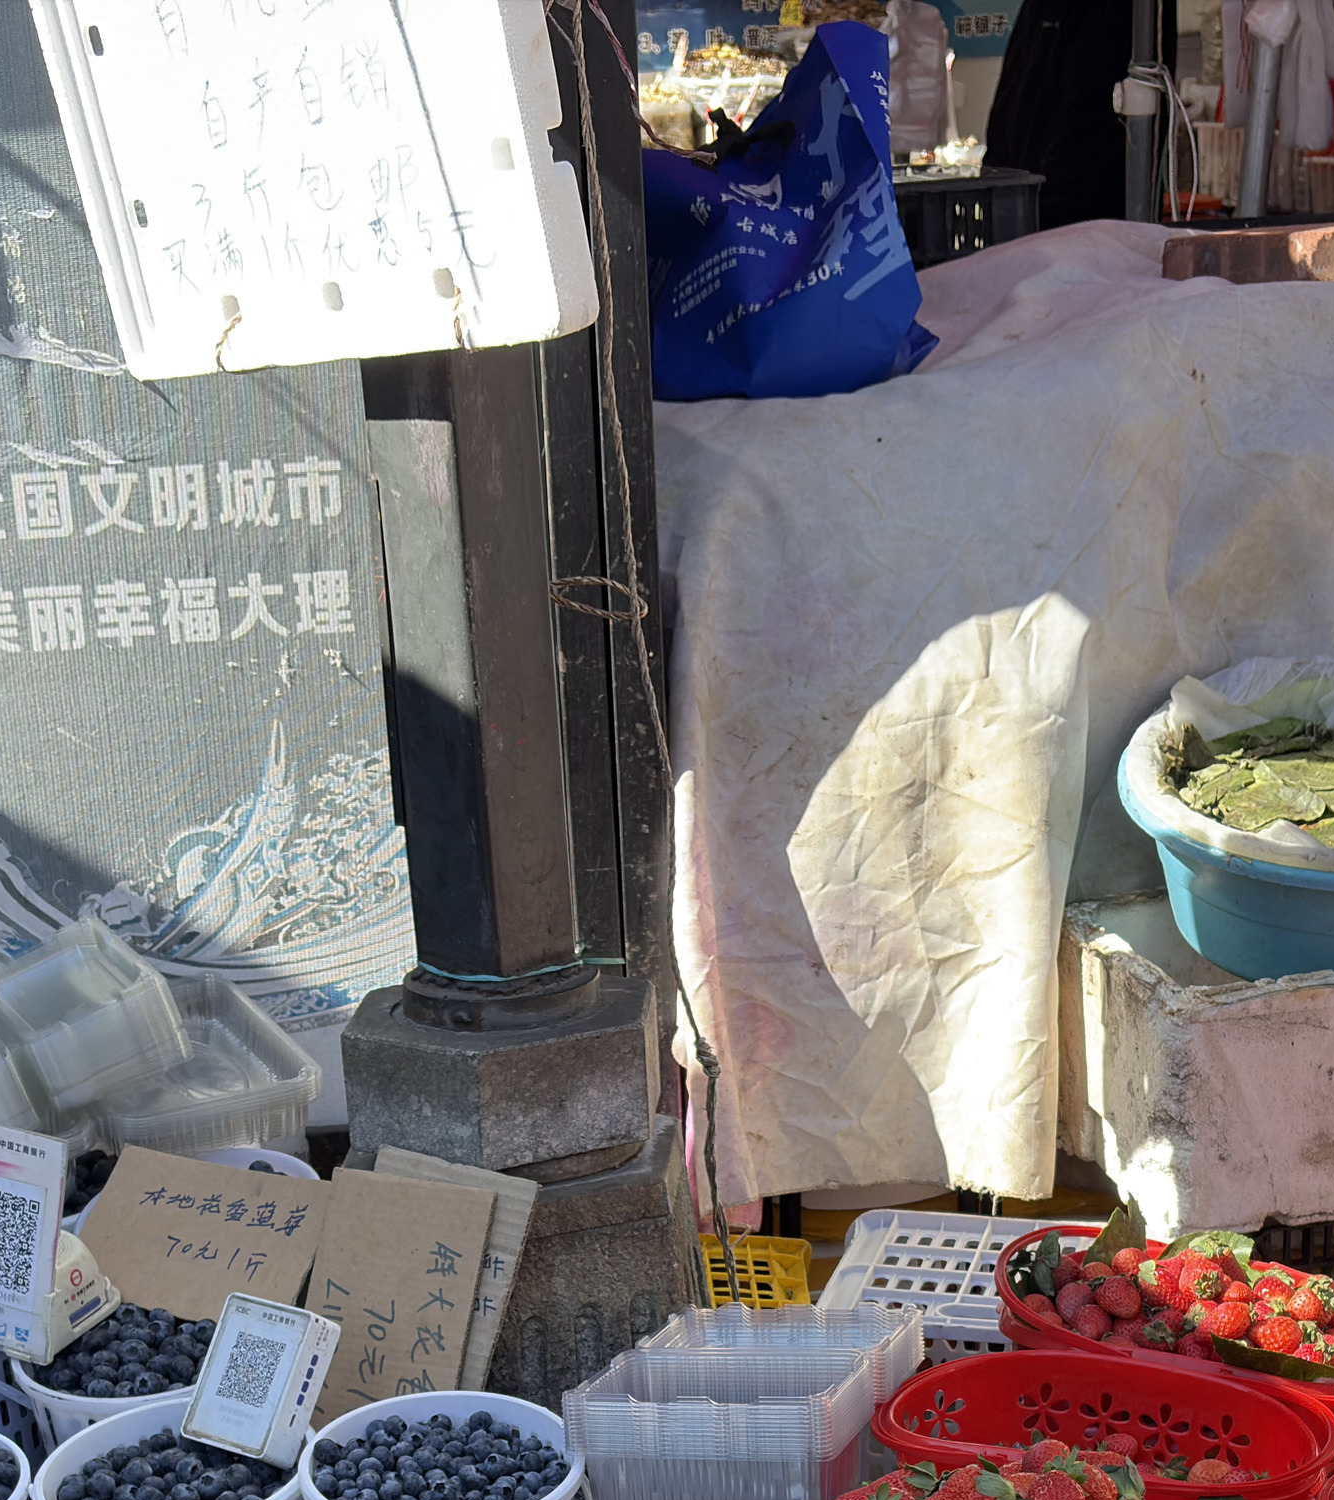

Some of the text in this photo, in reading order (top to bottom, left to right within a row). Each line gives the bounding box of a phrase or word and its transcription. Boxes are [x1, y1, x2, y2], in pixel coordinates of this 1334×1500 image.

[203, 40, 390, 150] 自产自销
[0, 1138, 46, 1160] 中国工商银行
[139, 1186, 308, 1237] 本地花香蓝莓
[167, 1235, 267, 1282] 70元1斤
[234, 1305, 251, 1316] ICBC
[262, 1311, 297, 1327] 中国工商银行
